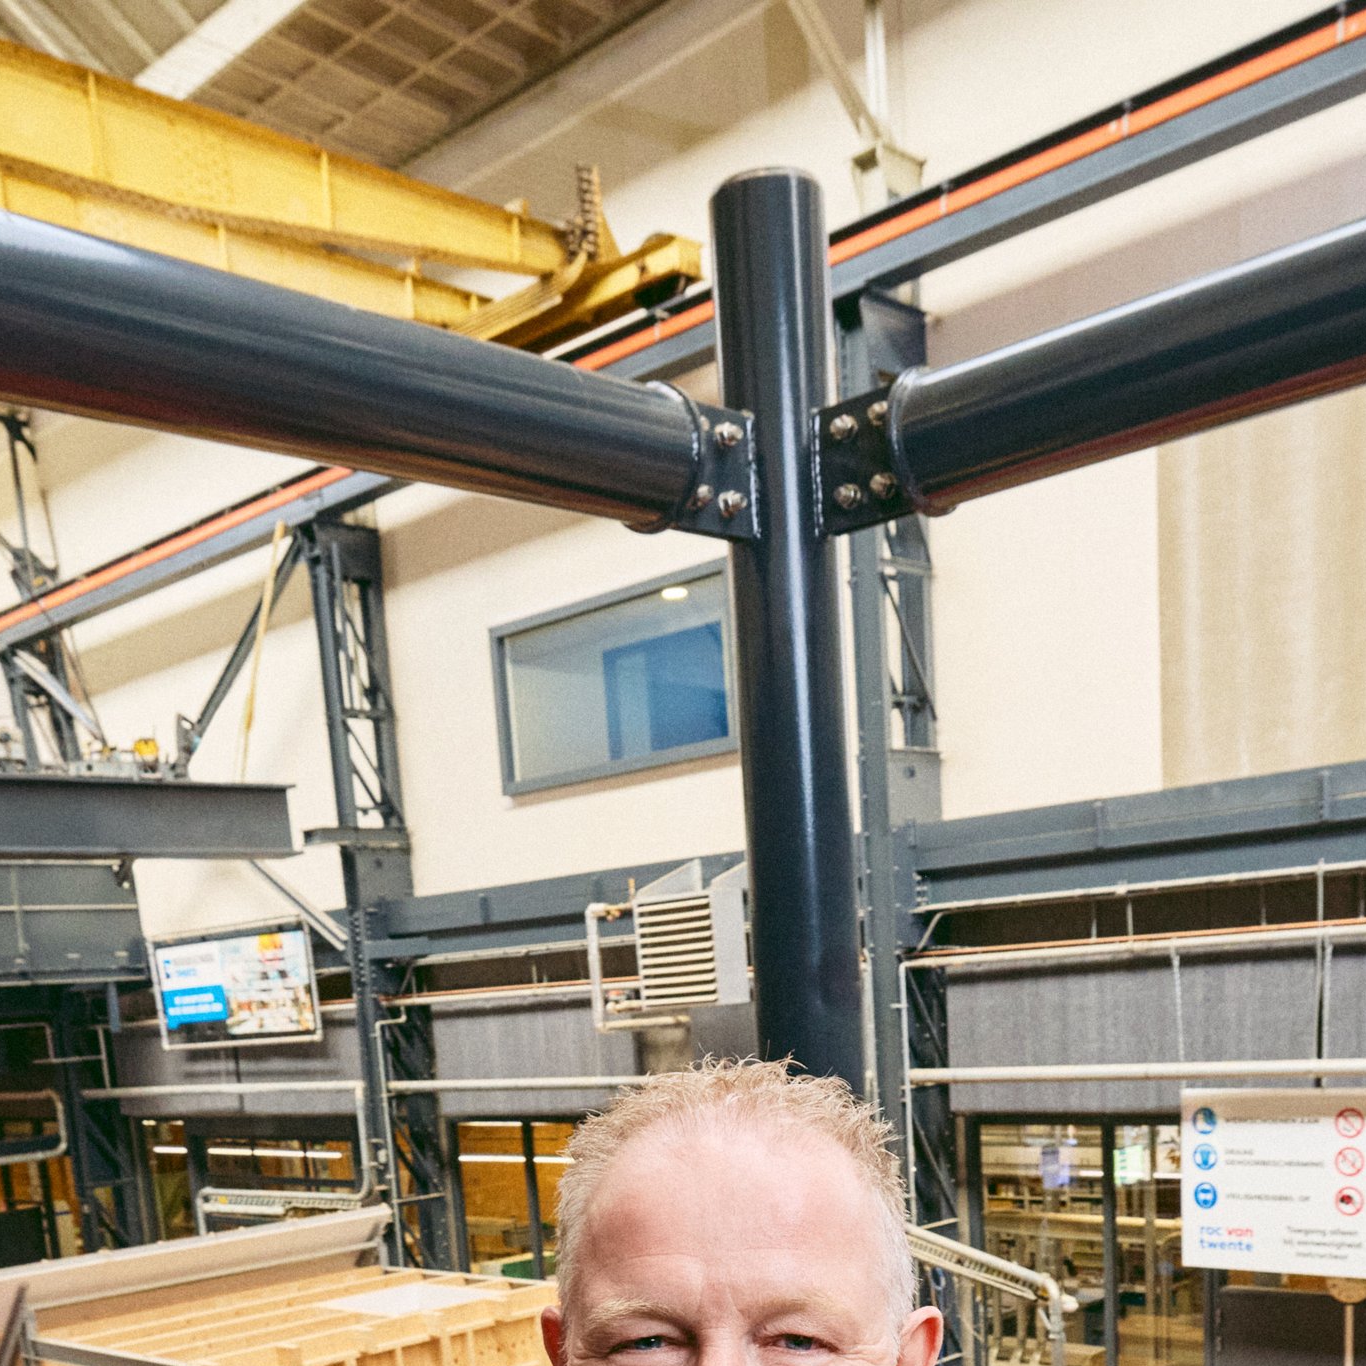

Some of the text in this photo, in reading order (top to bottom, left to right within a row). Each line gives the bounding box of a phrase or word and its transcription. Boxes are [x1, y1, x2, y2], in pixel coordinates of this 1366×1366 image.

[1199, 1226, 1254, 1237] roc van
[1199, 1239, 1254, 1252] twente
